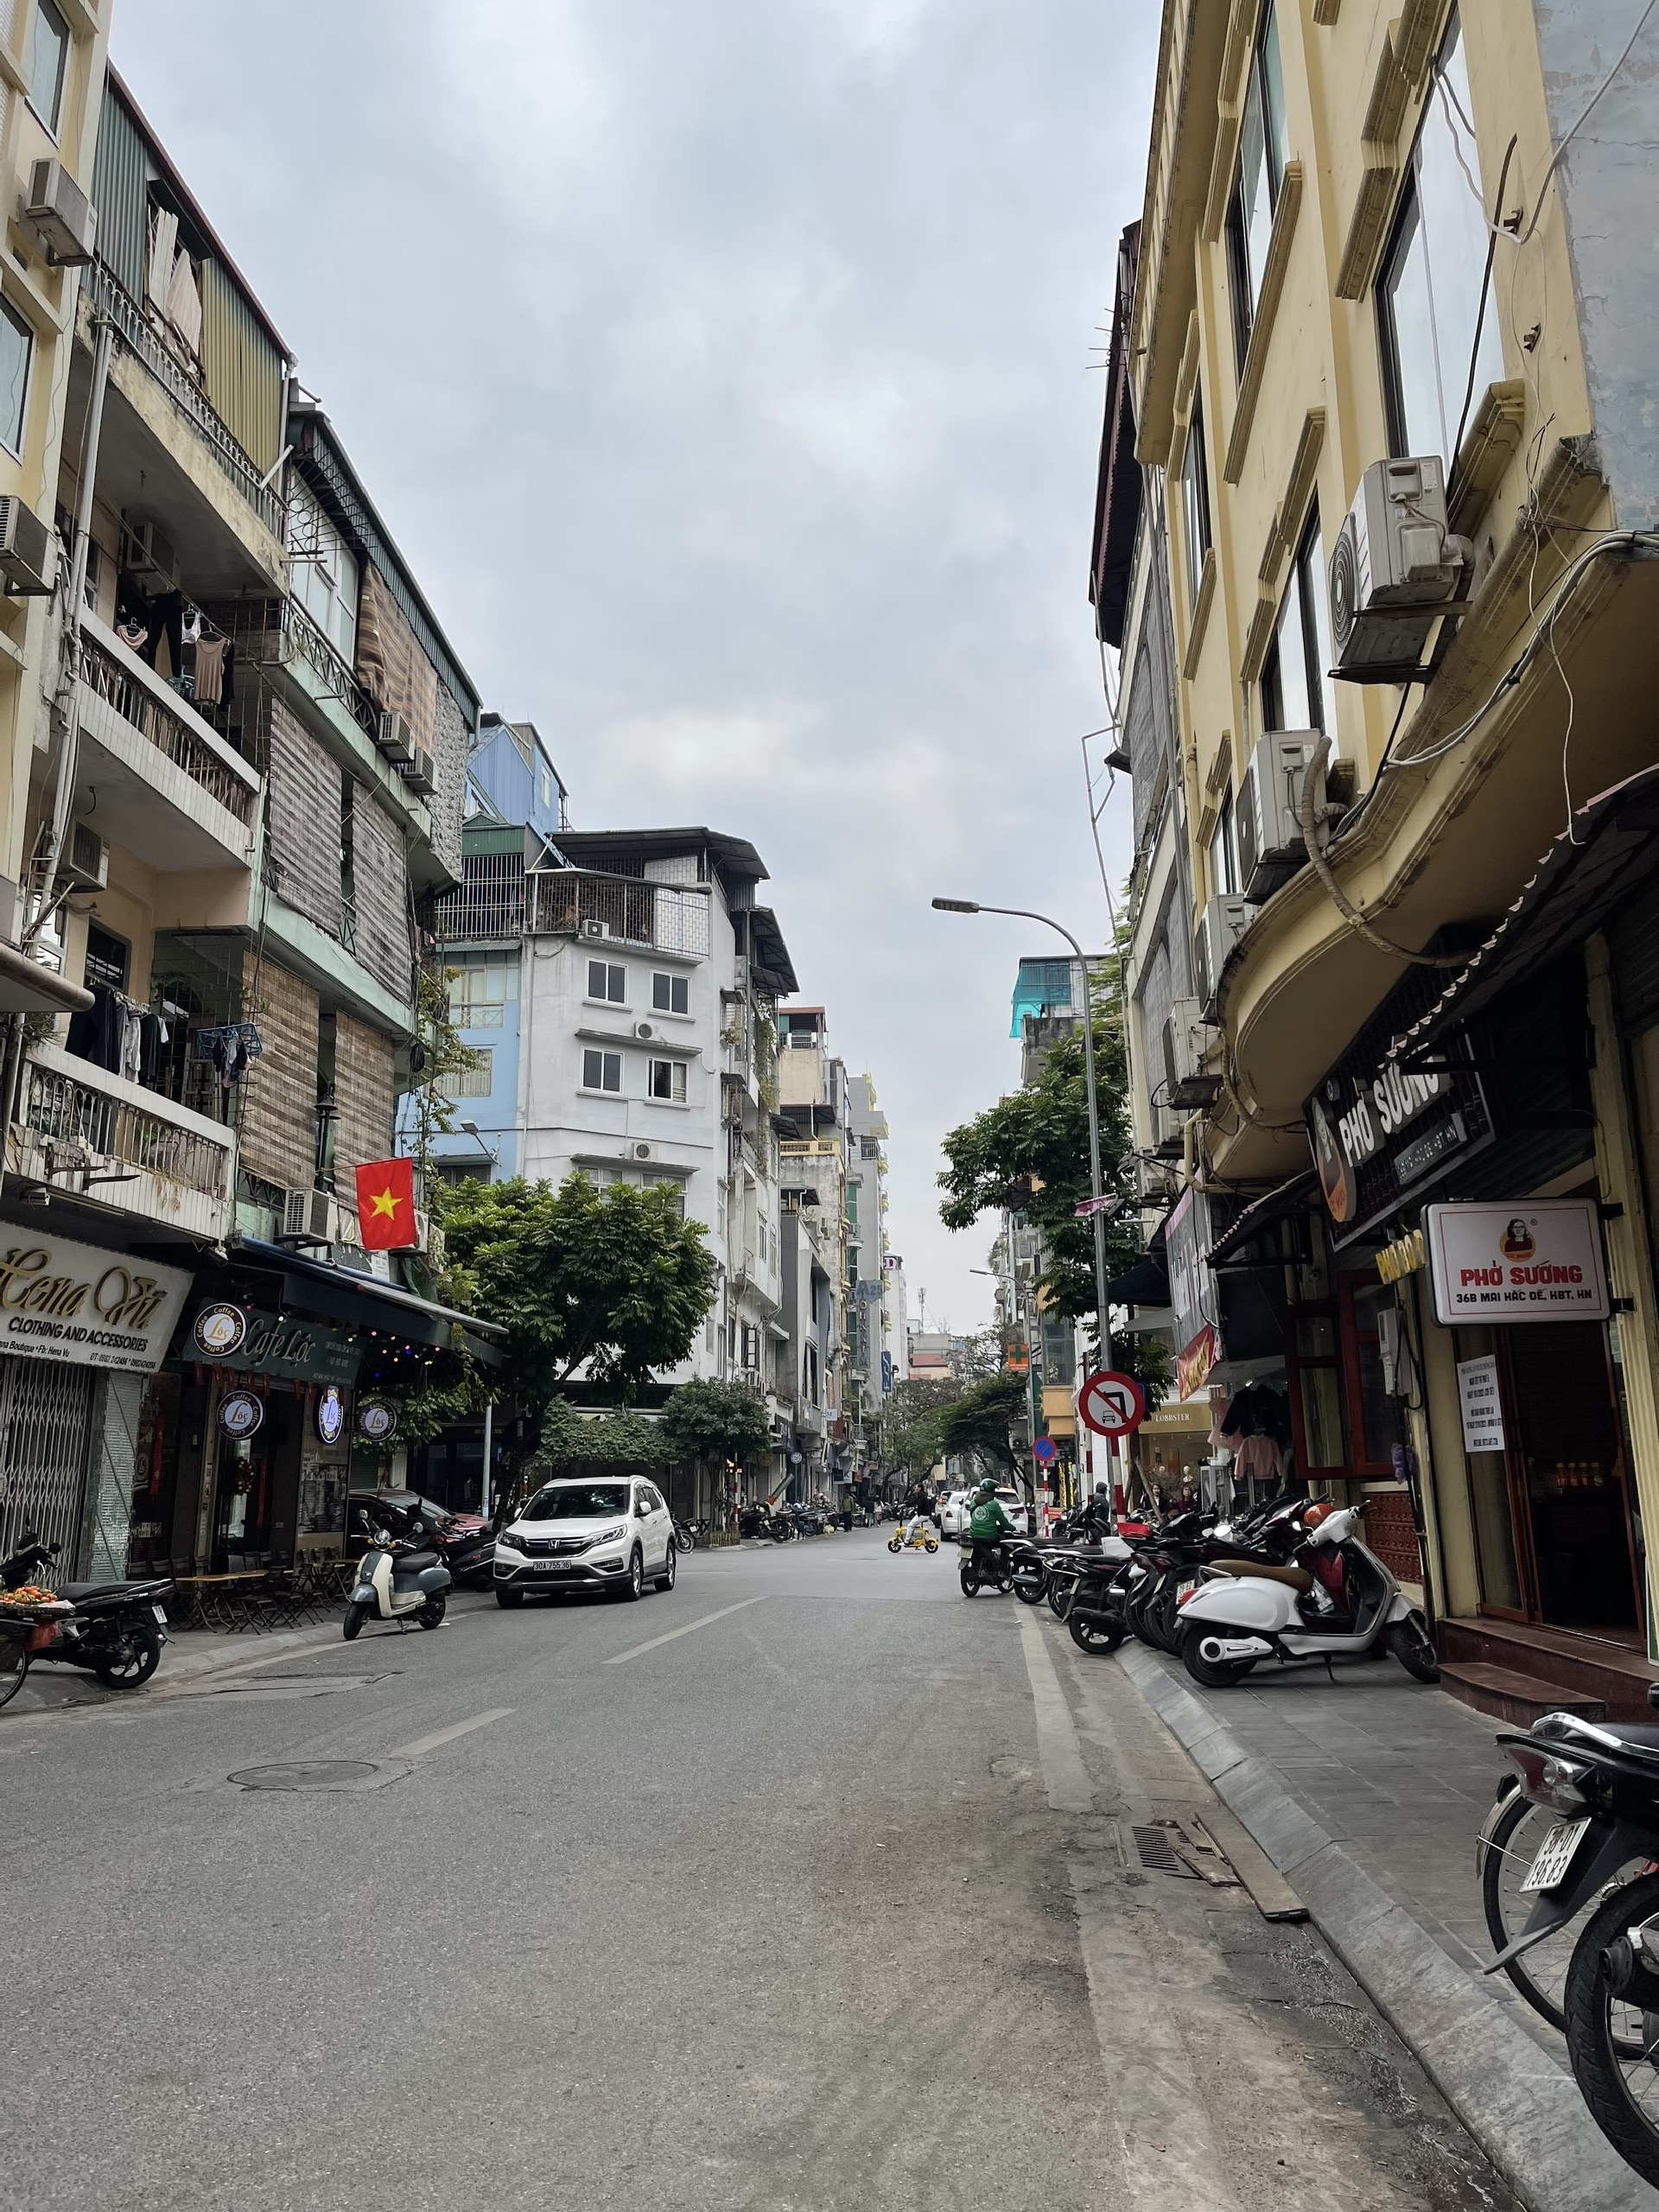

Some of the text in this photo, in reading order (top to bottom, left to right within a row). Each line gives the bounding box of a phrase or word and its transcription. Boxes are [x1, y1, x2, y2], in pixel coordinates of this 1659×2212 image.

[1460, 1260, 1583, 1287] PHỞ SƯỚNG
[1456, 1293, 1478, 1303] 36B
[1480, 1292, 1502, 1302] MAI
[1550, 1290, 1574, 1300] HBT,
[1577, 1288, 1592, 1299] HN
[213, 1306, 235, 1318] Coffee
[9, 1316, 149, 1352] CLOTHING AND ACCESSORIES
[197, 1315, 208, 1338] Coffee
[230, 1321, 242, 1344] Coffee
[203, 1342, 225, 1353] Coffee
